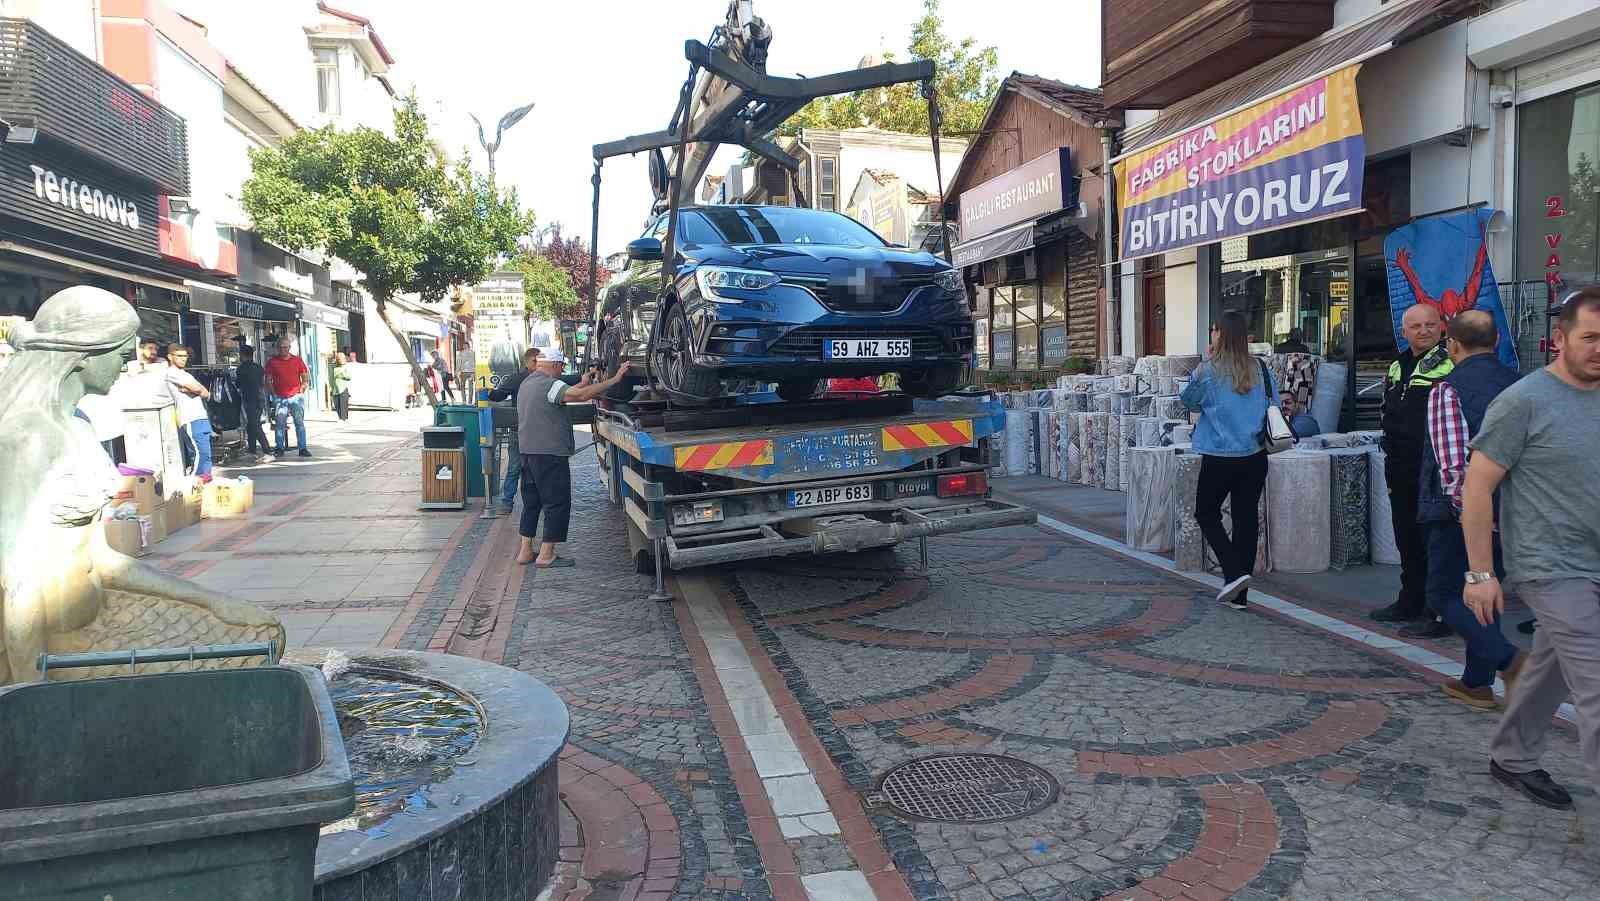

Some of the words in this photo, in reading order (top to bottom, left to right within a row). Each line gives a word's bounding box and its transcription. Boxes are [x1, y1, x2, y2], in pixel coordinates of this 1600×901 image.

[1131, 124, 1218, 194] FABRİKA
[1187, 92, 1326, 189] STOKLARINI
[995, 172, 1055, 214] RESTAURANT
[1130, 160, 1351, 252] BİTİRİYORUZ
[832, 341, 849, 357] 59
[856, 341, 880, 357] AHZ
[887, 341, 910, 356] 555
[796, 491, 812, 506] 22
[816, 489, 841, 504] ABP
[845, 486, 870, 501] 683
